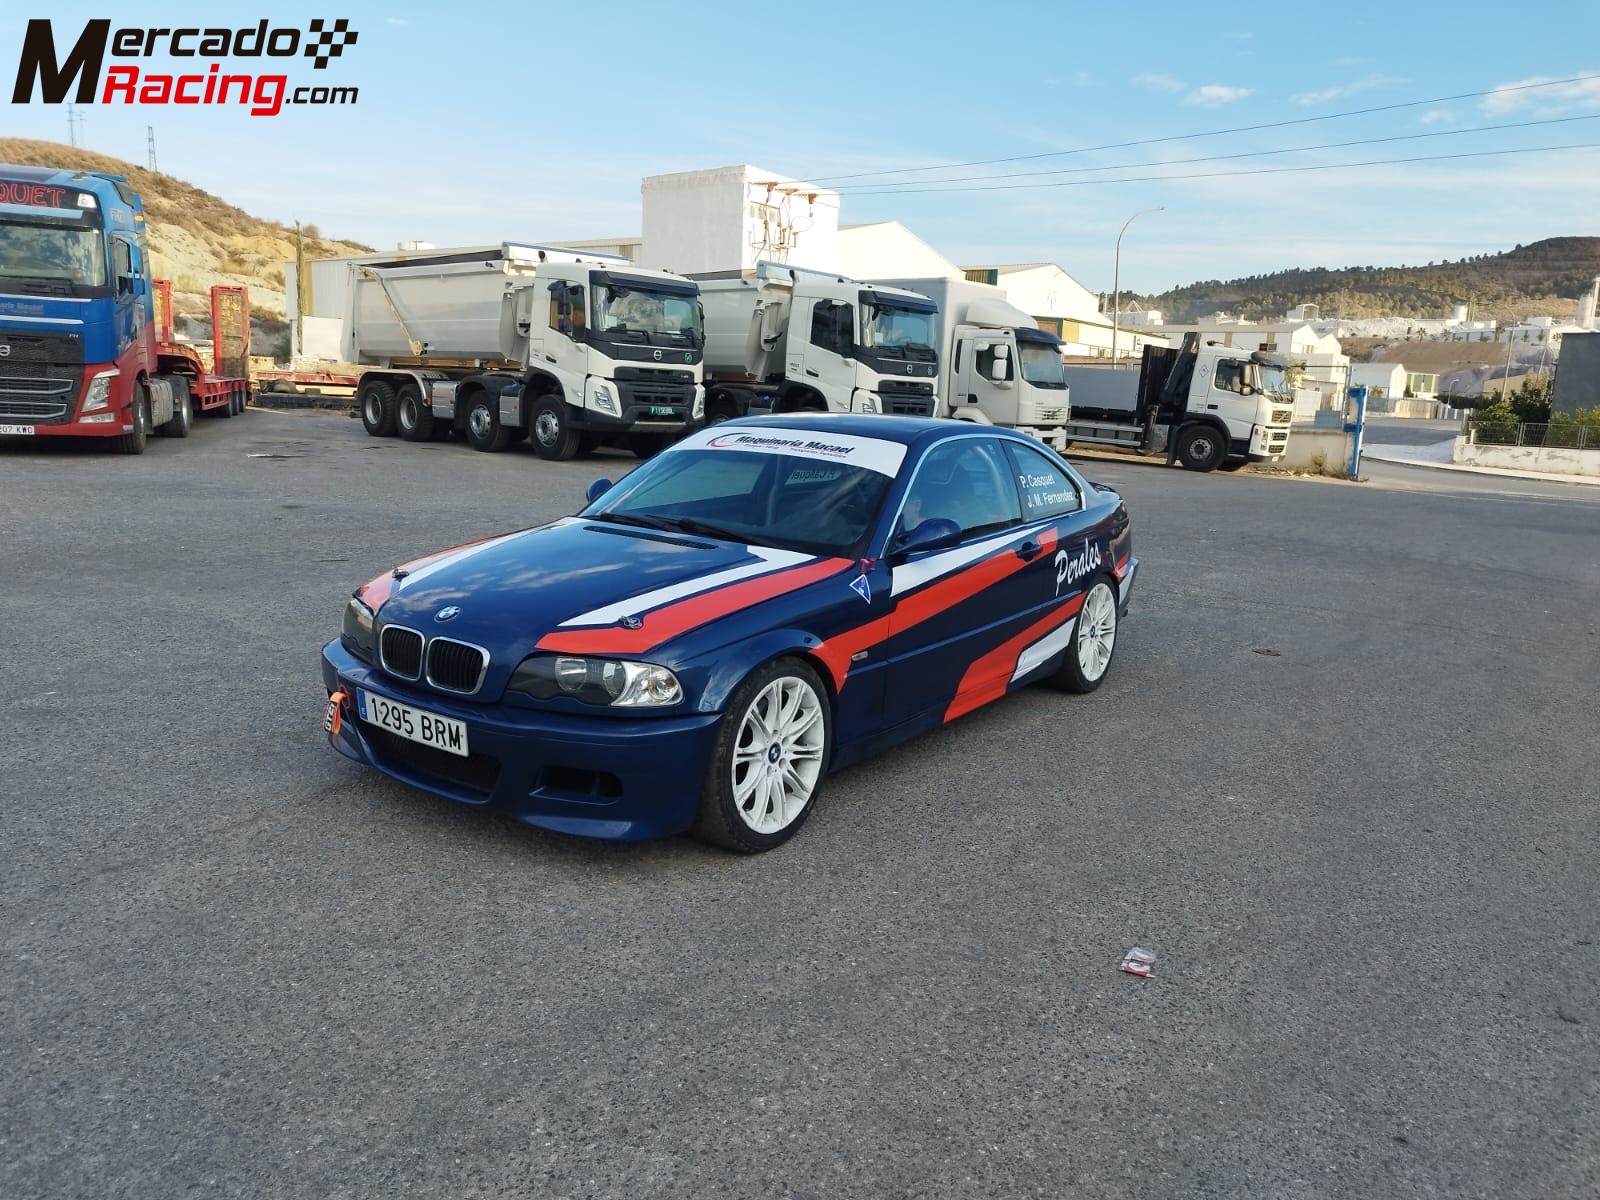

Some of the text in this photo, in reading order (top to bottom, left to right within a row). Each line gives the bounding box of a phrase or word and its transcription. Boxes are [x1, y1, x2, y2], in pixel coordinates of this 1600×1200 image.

[735, 435, 804, 448] Maquinaria
[805, 441, 855, 454] Macael
[1019, 474, 1056, 489] P. Casquet
[1027, 494, 1035, 508] J.
[1054, 537, 1101, 597] Perales
[371, 698, 462, 751] 1295 BRM
